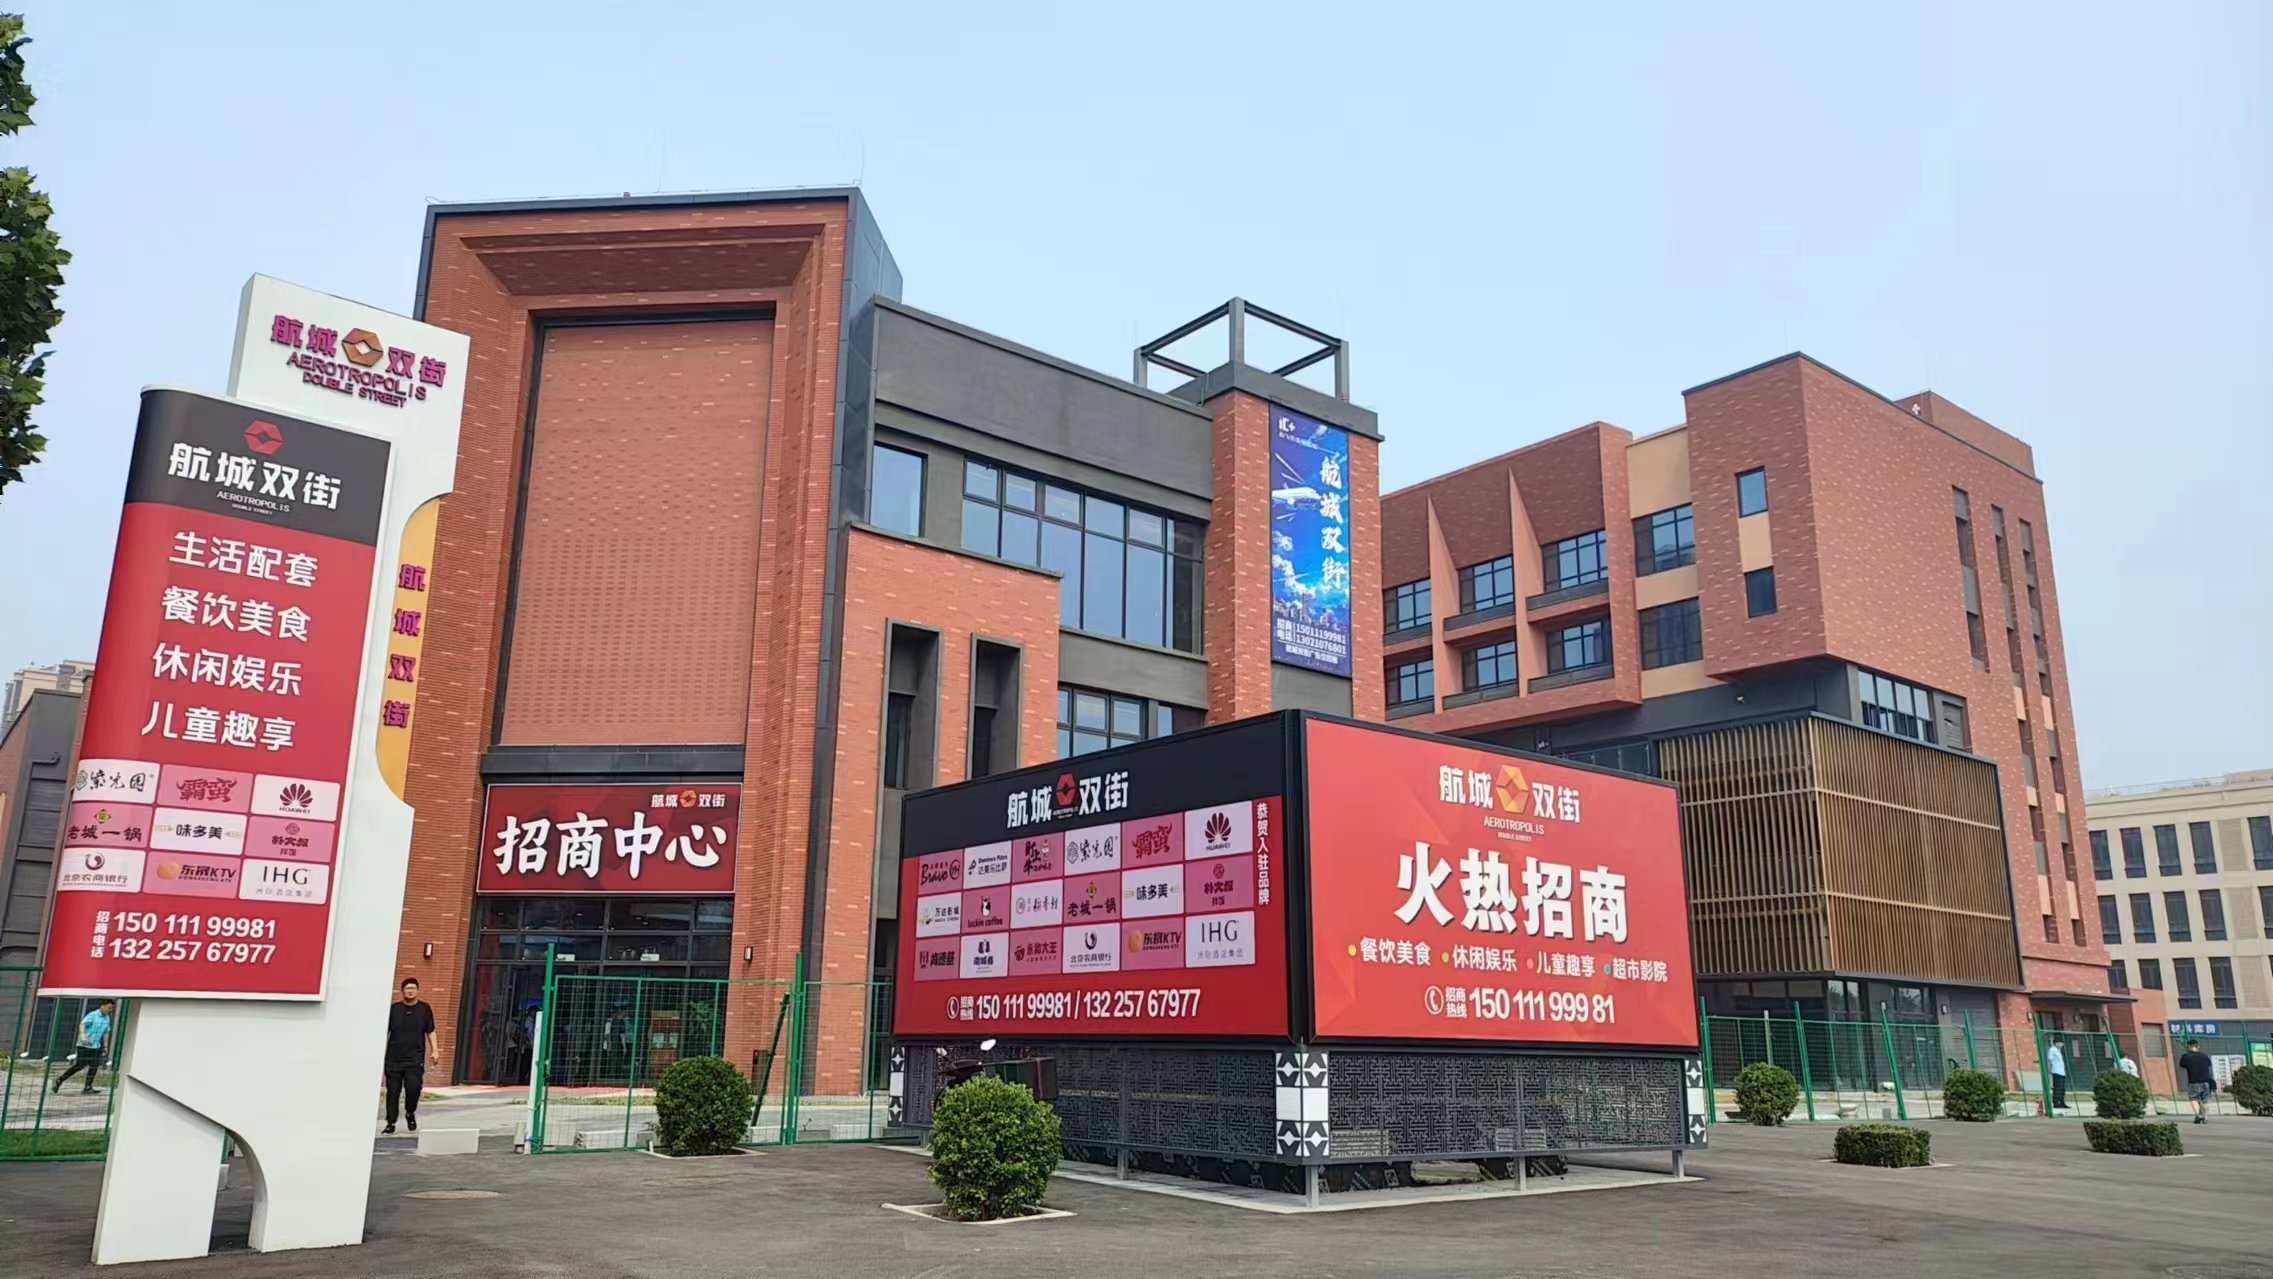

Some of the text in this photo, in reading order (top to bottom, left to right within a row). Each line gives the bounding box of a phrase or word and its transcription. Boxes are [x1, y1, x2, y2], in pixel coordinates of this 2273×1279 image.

[271, 315, 446, 387] 航城 双街
[287, 351, 426, 400] AEROTROPOLIS
[303, 372, 407, 408] DOUBLE STREET
[168, 441, 341, 510] 航城双街
[216, 490, 290, 512] AEROTROPOLIS
[1320, 456, 1344, 589] 航城双街
[169, 530, 318, 588] 生活配套
[161, 586, 311, 642] 餐饮美食
[383, 564, 427, 728] 航城双街
[152, 642, 302, 697] 休闲娱乐
[140, 700, 296, 752] 儿童趣享
[90, 769, 146, 792] 紫光园
[176, 777, 238, 802] 霸蛮
[651, 794, 726, 808] 航城 双街
[1007, 772, 1128, 828] 航城 双街
[1439, 765, 1580, 823] 航城 双街
[278, 806, 311, 815] HUAWEI
[68, 825, 142, 842] 老城一锅
[176, 824, 222, 840] 味多美
[1484, 816, 1544, 835] AEROTROPOLIS
[493, 811, 727, 879] 招商中心
[1080, 836, 1113, 862] 紫光园
[1132, 821, 1172, 859] 霸蛮
[1206, 842, 1231, 851] HUAWEI
[1257, 802, 1270, 906] 恭贺入驻品牌
[263, 865, 308, 885] IHG
[1136, 883, 1168, 901] 味多美
[1394, 841, 1628, 944] 火热招商
[1067, 898, 1117, 917] 老城一锅
[90, 911, 110, 958] 招商电话
[114, 912, 276, 938] 150 111 99981
[967, 918, 985, 928] luckin
[985, 917, 1003, 927] coffee
[1201, 920, 1238, 943] IHG
[109, 938, 276, 964] 132 257 67977
[930, 951, 955, 967] 肯德基
[1360, 937, 1431, 967] 餐饮美食
[1452, 945, 1518, 973] 休闲娱乐
[1536, 952, 1596, 978] 儿童趣享
[1612, 957, 1668, 982] 超市影院
[977, 989, 1201, 1020] 150 111 99981 / 132 257 67977
[1445, 986, 1465, 1002] 招商
[1469, 987, 1615, 1023] 150 111 999 81
[1446, 1002, 1467, 1019] 热线
